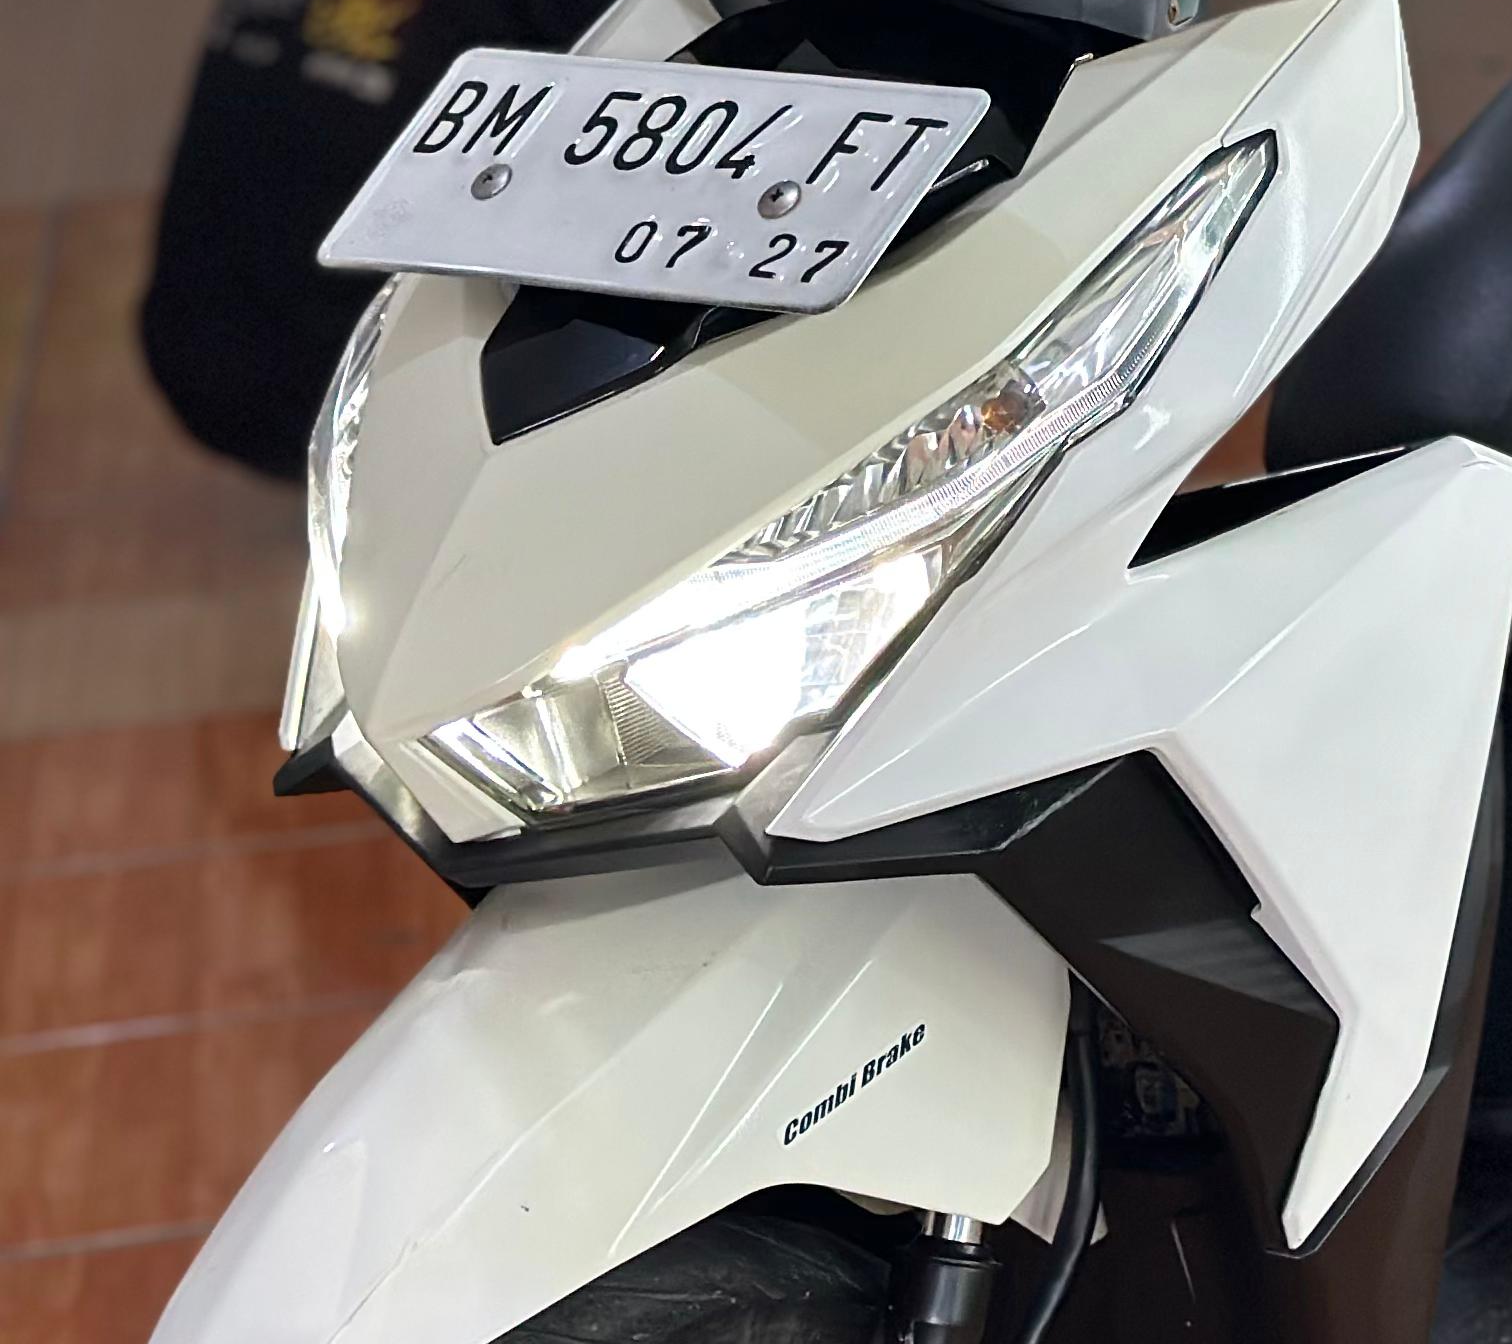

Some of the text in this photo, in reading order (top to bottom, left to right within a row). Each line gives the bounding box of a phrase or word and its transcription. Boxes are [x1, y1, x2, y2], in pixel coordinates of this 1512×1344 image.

[411, 80, 949, 192] BM 5804 FT
[614, 220, 849, 284] 07 27
[783, 1023, 926, 1146] Combi Brake
